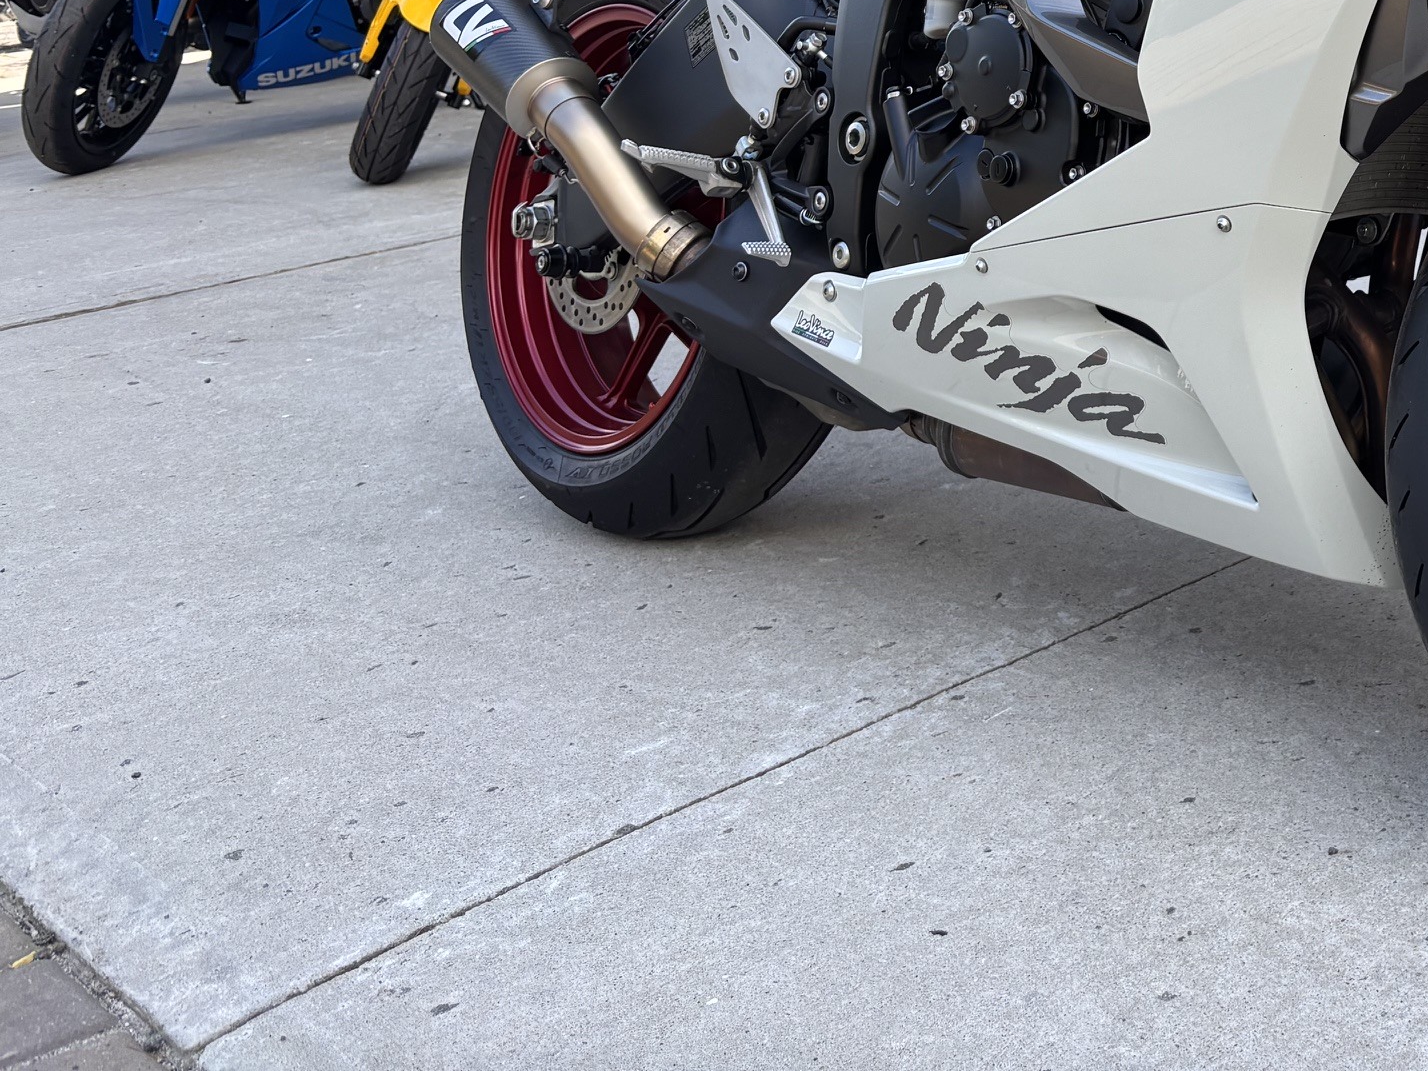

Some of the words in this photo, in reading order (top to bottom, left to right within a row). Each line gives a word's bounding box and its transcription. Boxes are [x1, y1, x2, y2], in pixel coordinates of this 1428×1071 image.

[257, 51, 357, 87] SUZUKI
[796, 309, 834, 339] LeoVince
[892, 282, 1167, 445] Ninja
